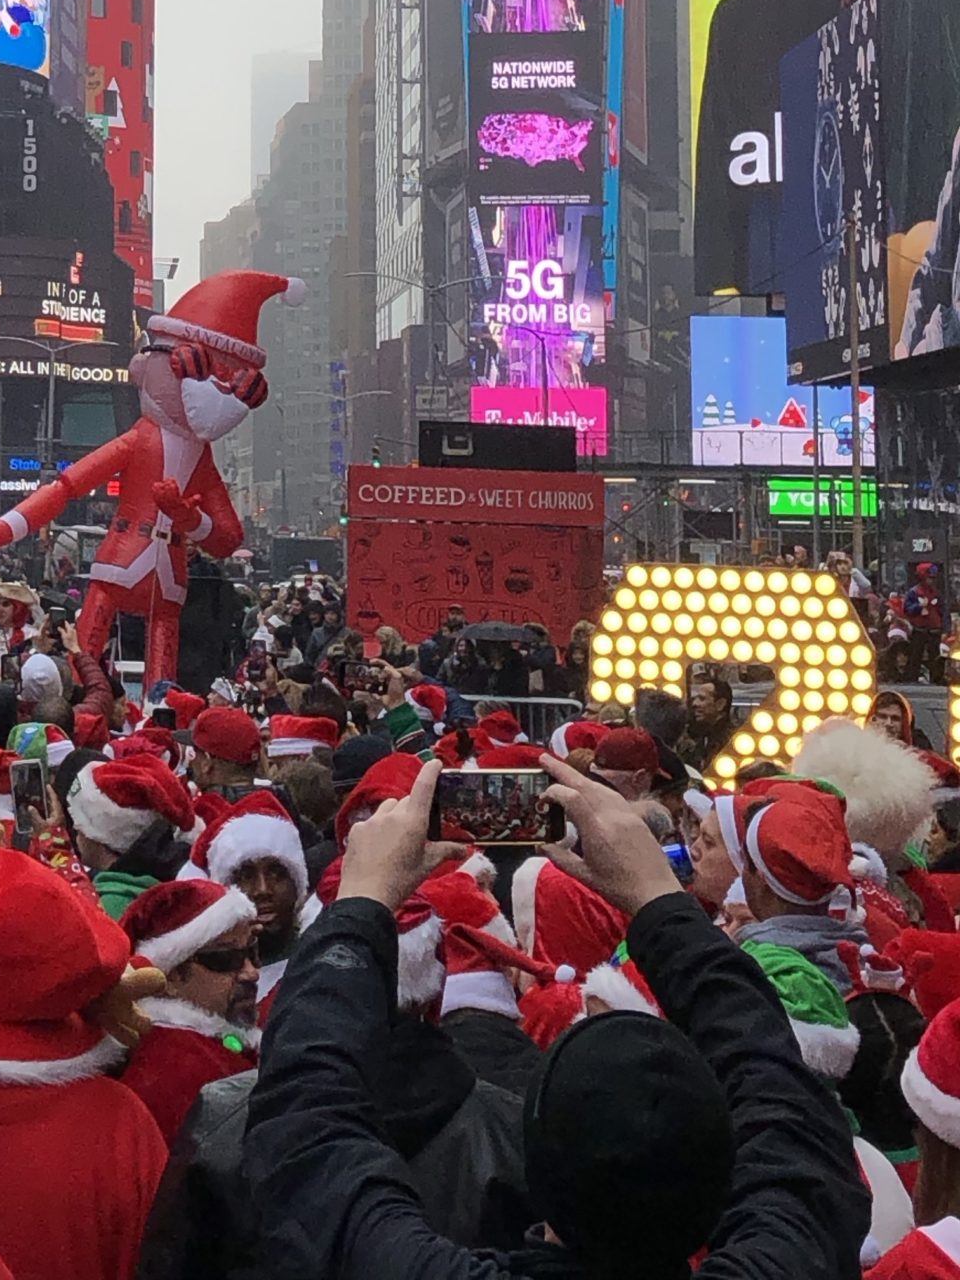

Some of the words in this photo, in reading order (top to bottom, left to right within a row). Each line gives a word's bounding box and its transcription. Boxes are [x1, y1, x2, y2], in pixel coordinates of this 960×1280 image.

[493, 61, 575, 75] NATIONWIDE
[491, 77, 508, 89] 5G
[511, 75, 576, 89] NETWORK
[22, 119, 38, 192] 1500
[729, 112, 783, 186] al
[506, 259, 565, 300] 5G
[47, 281, 60, 298] IN
[68, 289, 87, 305] OF
[91, 291, 101, 307] A
[483, 304, 547, 323] FROM
[554, 303, 591, 323] BIG
[9, 361, 35, 375] ALL
[37, 362, 50, 376] IN
[71, 367, 113, 382] GOOD
[358, 484, 466, 507] COFFEED
[478, 488, 524, 508] SWEET
[528, 490, 594, 511] CHURROS
